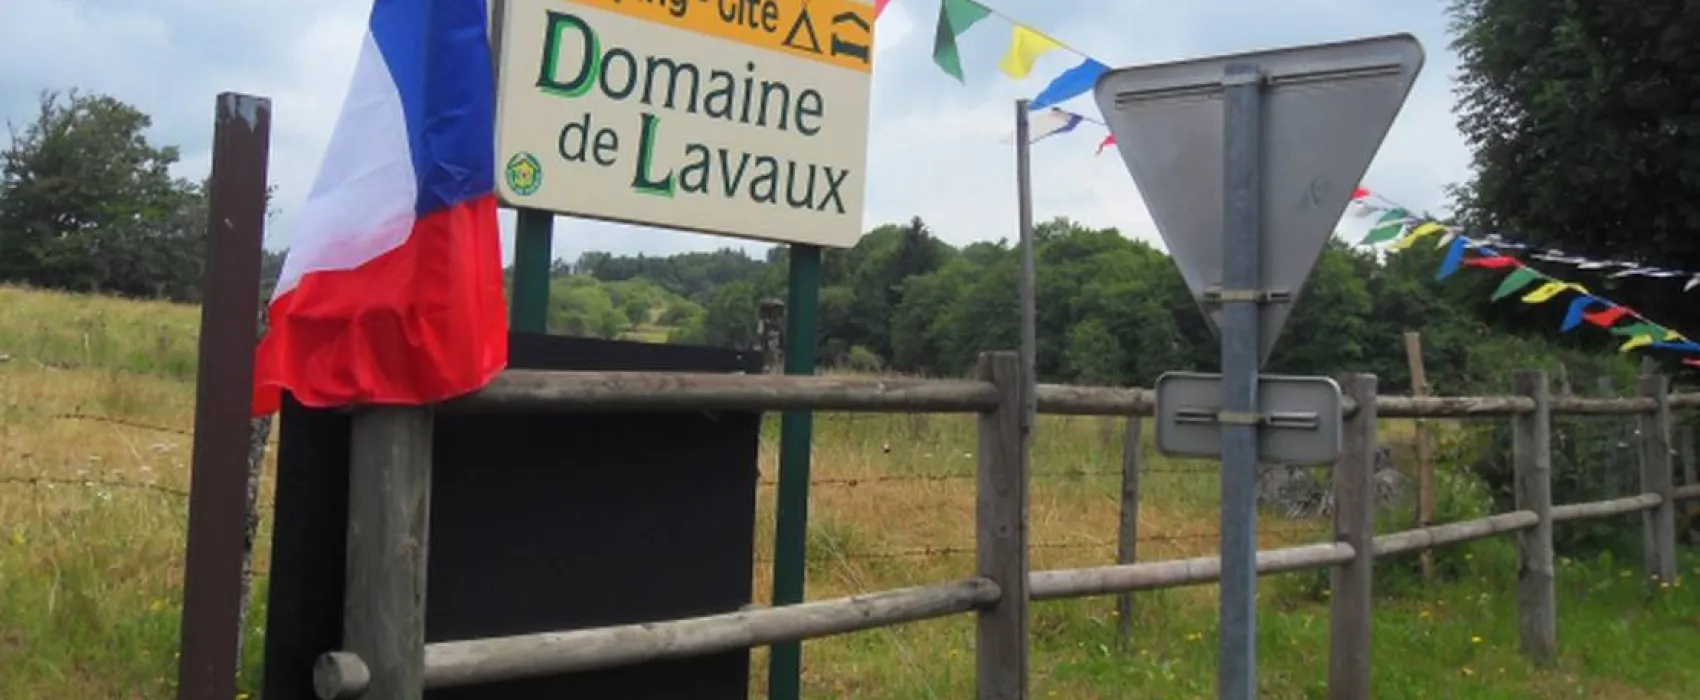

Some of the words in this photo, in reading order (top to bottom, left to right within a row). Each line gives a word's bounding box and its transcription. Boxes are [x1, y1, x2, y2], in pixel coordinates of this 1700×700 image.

[535, 9, 824, 136] Domaine
[558, 113, 619, 166] de
[631, 113, 850, 214] Lavaux
